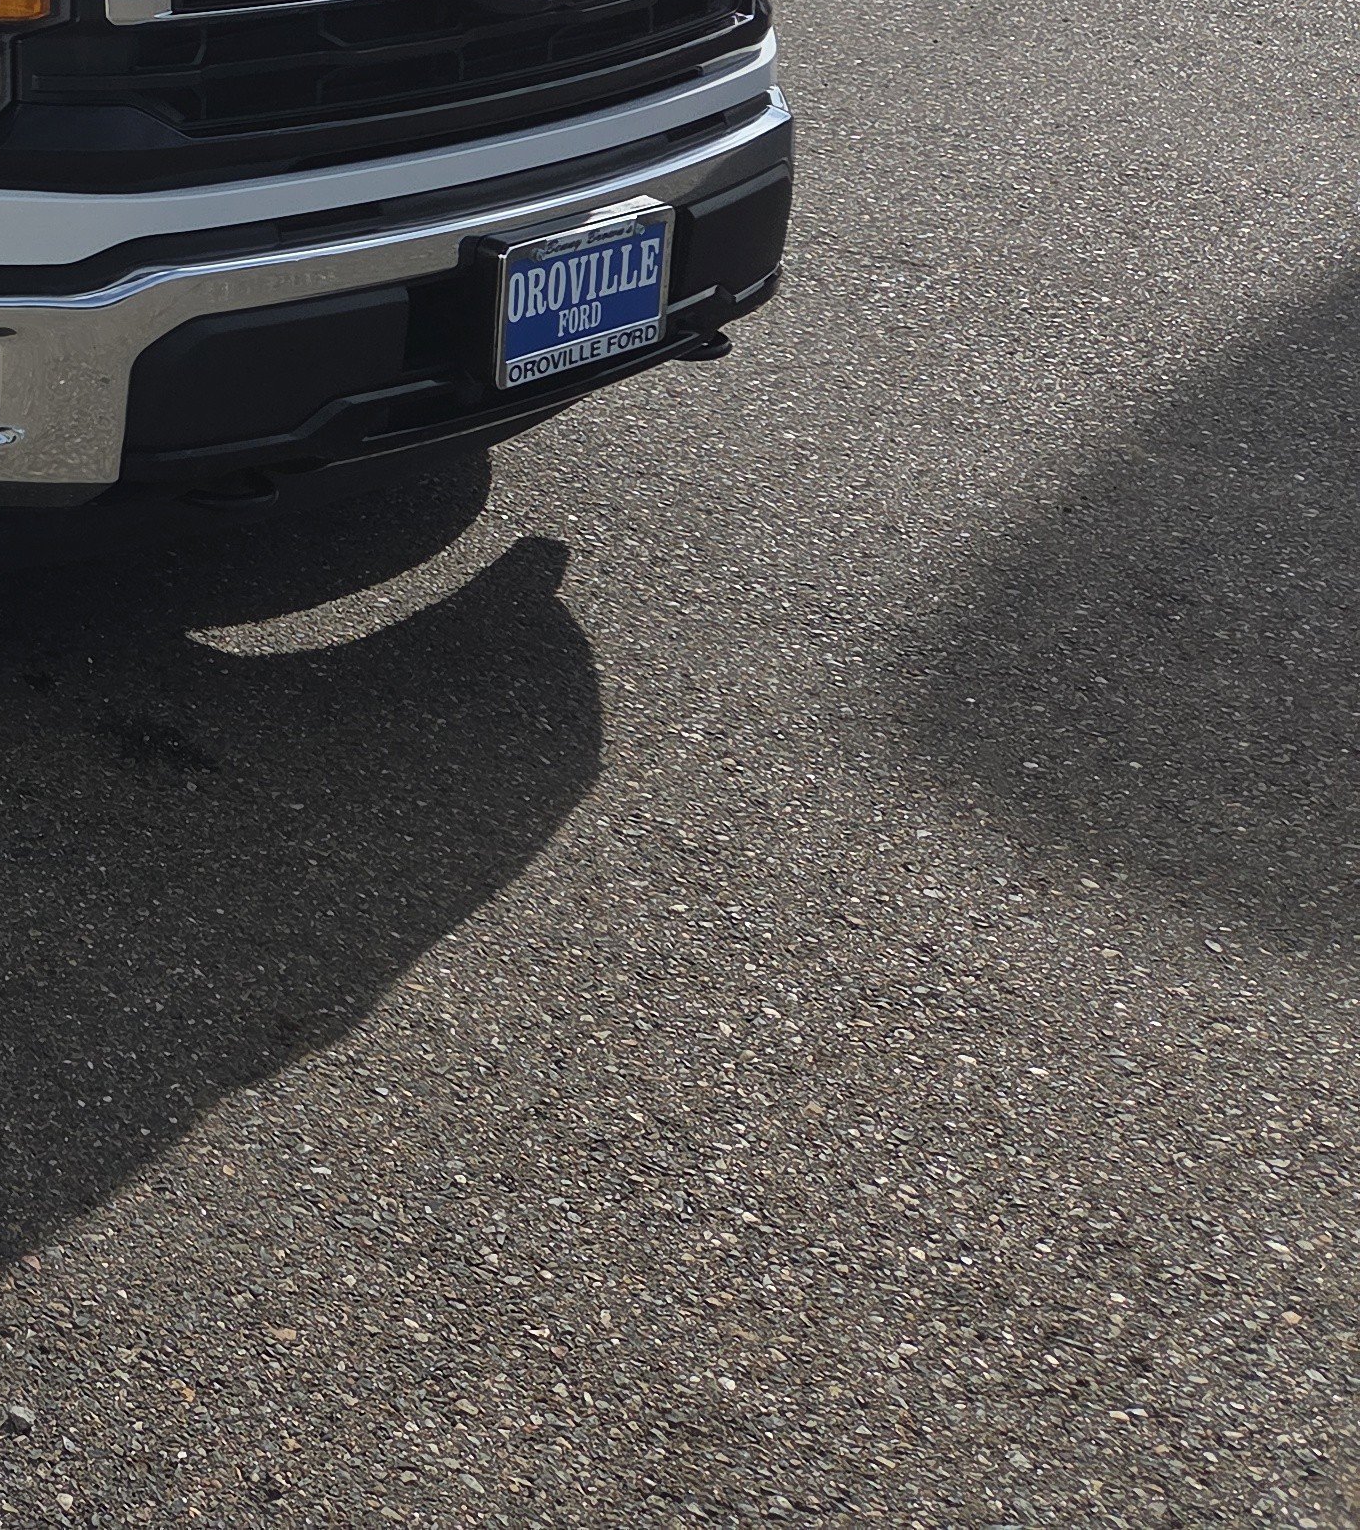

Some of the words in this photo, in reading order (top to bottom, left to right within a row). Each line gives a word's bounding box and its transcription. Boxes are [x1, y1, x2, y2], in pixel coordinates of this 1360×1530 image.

[507, 237, 661, 323] OROVILLE
[557, 300, 602, 337] FORD
[508, 339, 602, 384] OROVILLE
[606, 323, 658, 355] FORD
